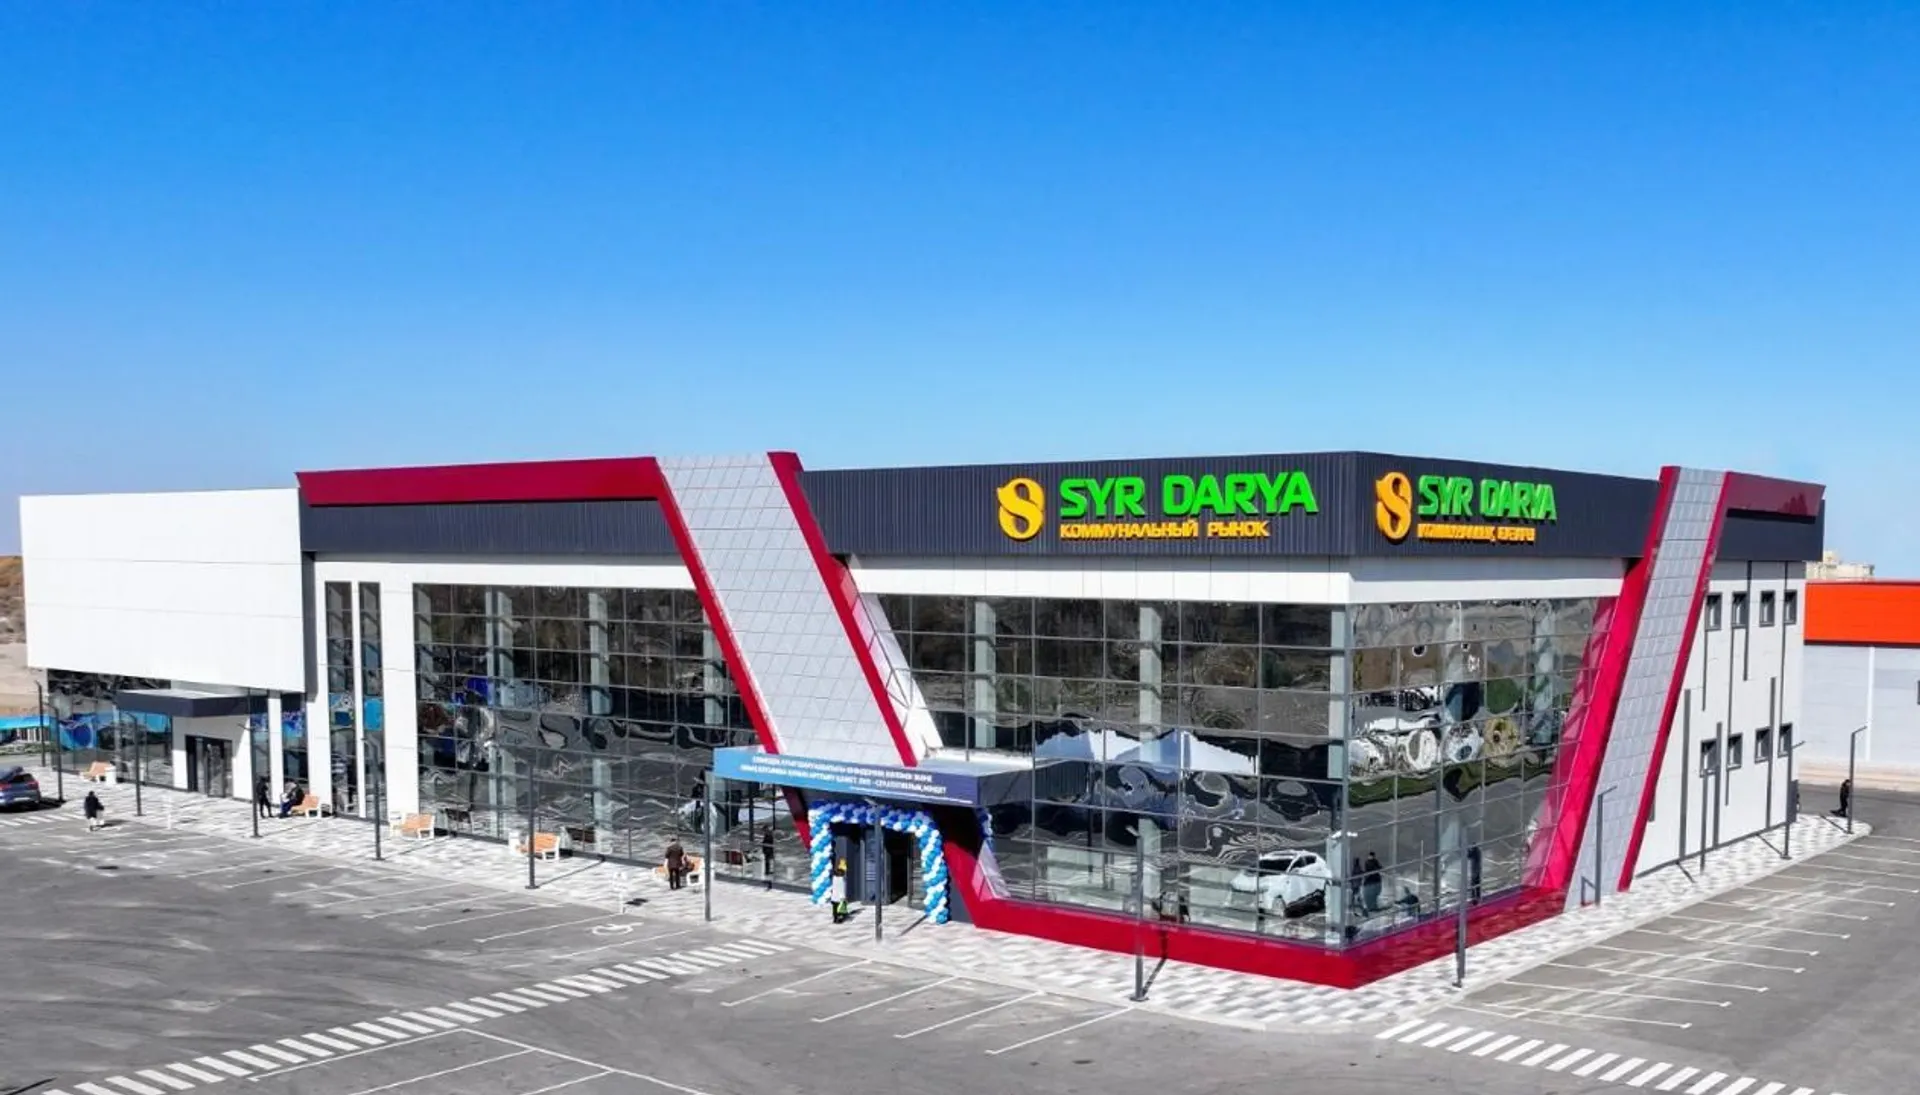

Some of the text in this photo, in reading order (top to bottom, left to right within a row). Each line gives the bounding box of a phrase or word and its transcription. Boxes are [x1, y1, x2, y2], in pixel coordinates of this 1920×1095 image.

[1060, 471, 1318, 517] SYR DARYA
[1418, 475, 1557, 520] SYR DARYA
[1060, 520, 1270, 539] КОММУНАЛЬНЫЙ РЫНОК
